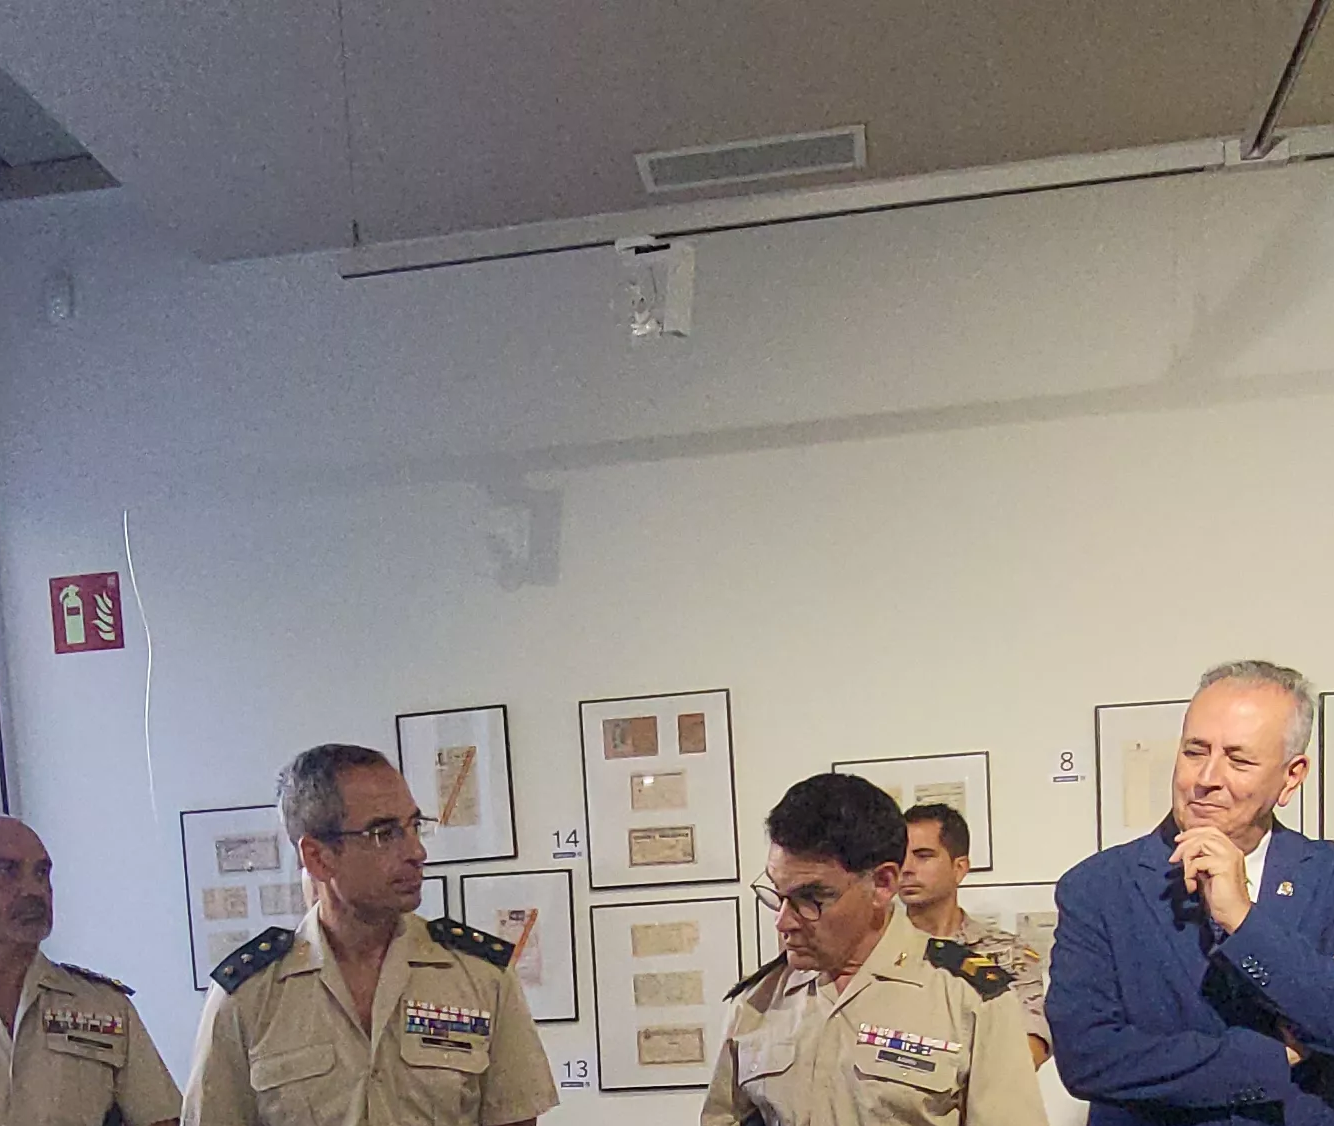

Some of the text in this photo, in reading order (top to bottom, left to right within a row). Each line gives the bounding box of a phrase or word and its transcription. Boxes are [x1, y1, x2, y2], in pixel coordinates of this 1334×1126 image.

[1060, 751, 1074, 771] 8
[552, 829, 580, 849] 14
[563, 1060, 588, 1078] 13
